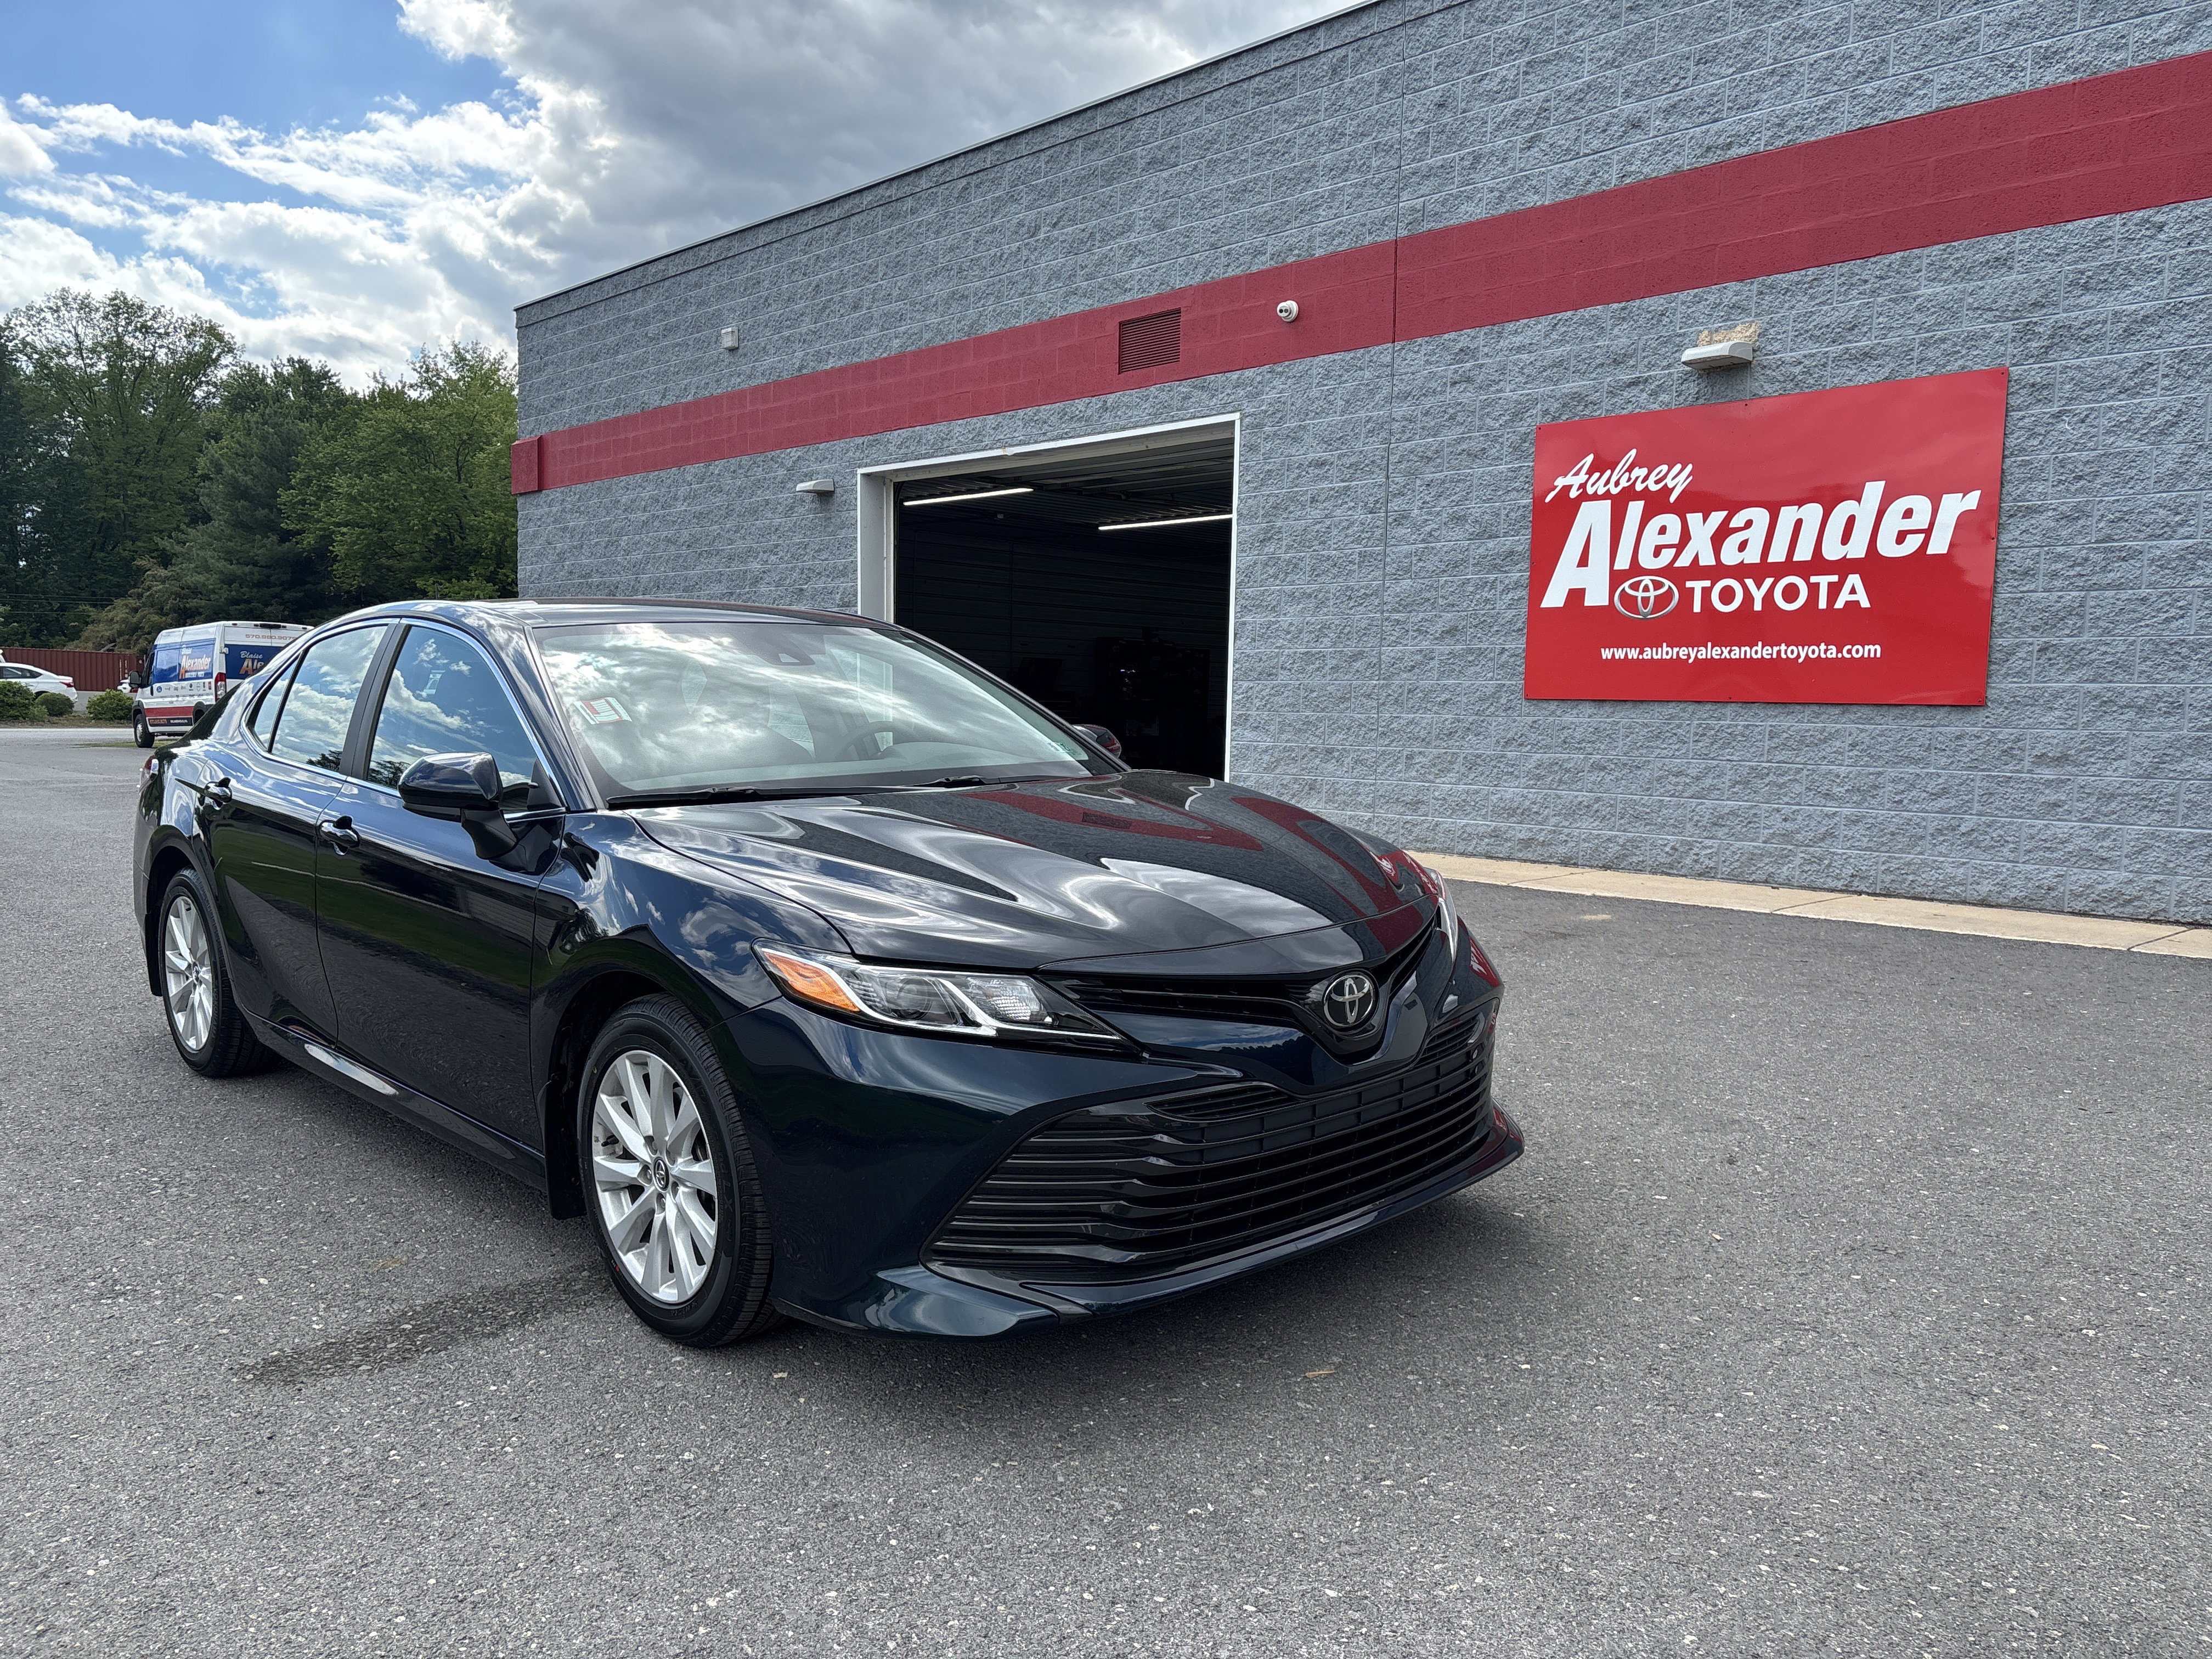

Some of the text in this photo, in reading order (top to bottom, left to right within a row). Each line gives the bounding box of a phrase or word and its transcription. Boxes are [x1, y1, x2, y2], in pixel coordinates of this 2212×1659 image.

[1544, 448, 1694, 504] Aubrey
[1541, 481, 1982, 608] Alexander
[1686, 573, 1872, 613] TOYOTA
[179, 654, 211, 679] Alexander
[1600, 641, 1882, 664] www.aubreyalexandertoyota.com
